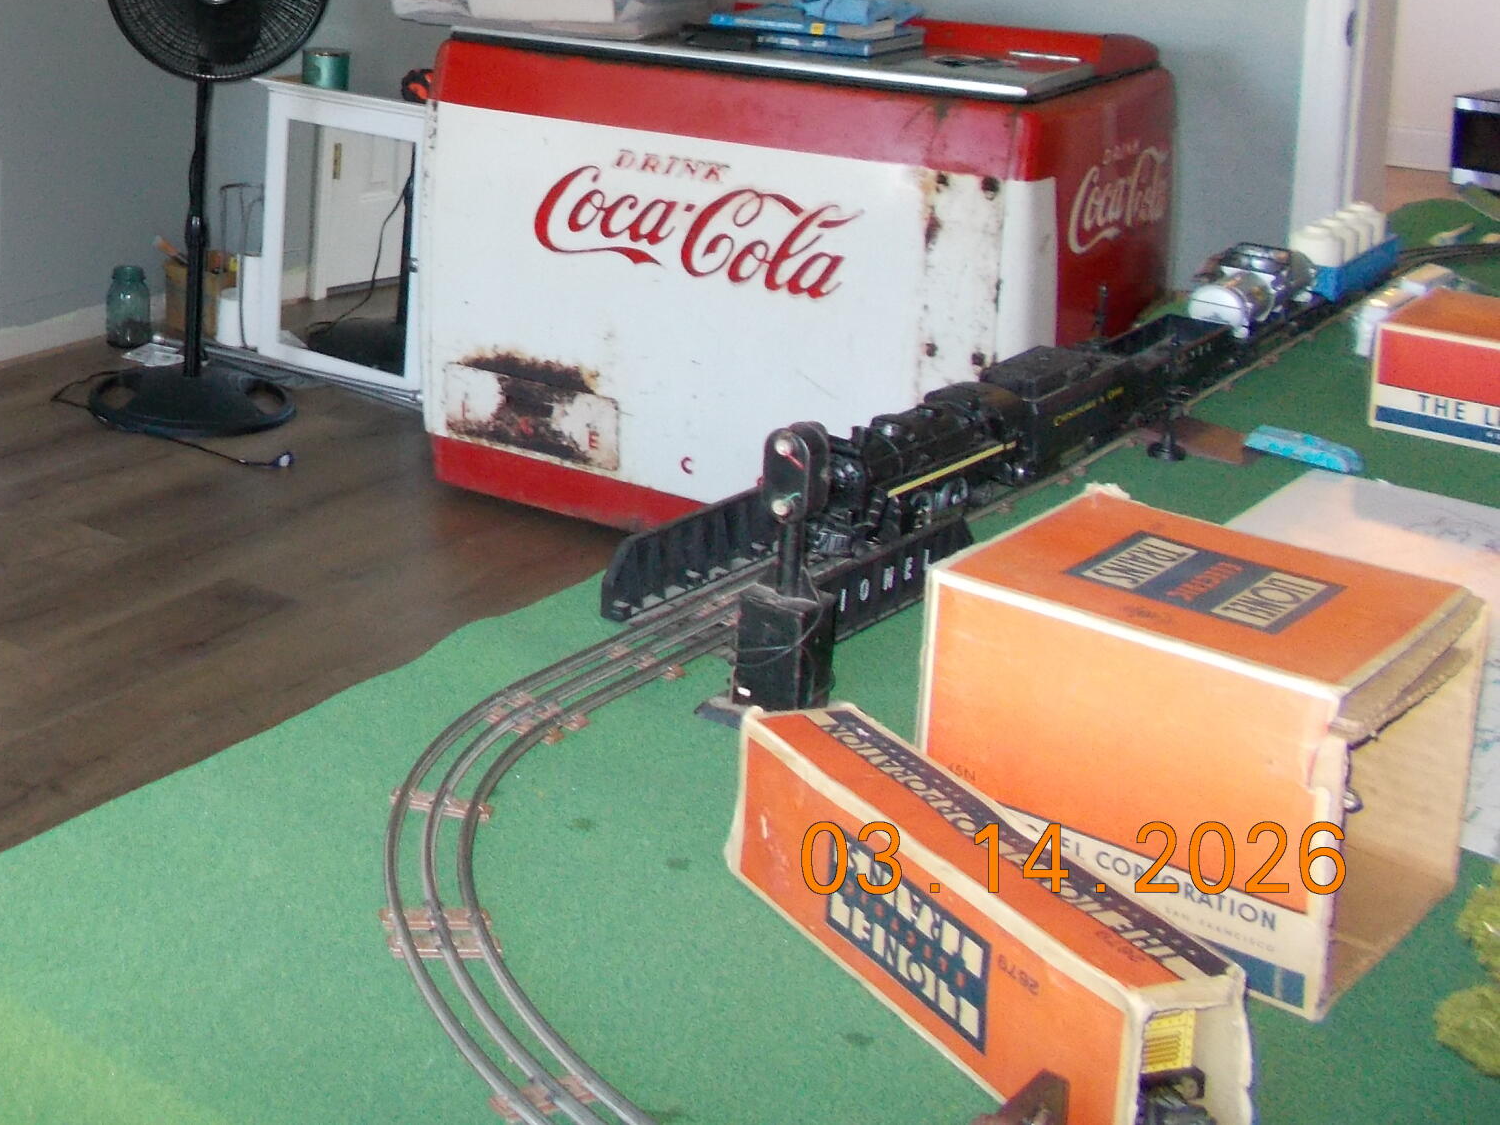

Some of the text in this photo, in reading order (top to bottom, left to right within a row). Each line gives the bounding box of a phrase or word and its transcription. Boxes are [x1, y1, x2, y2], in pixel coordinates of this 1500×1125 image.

[612, 149, 731, 182] DRINK
[534, 164, 865, 299] Coca-Cola
[1417, 393, 1465, 421] THE
[1093, 542, 1186, 585] TRAINS
[1224, 577, 1317, 625] LIONEL
[840, 897, 963, 1027] LIONEL
